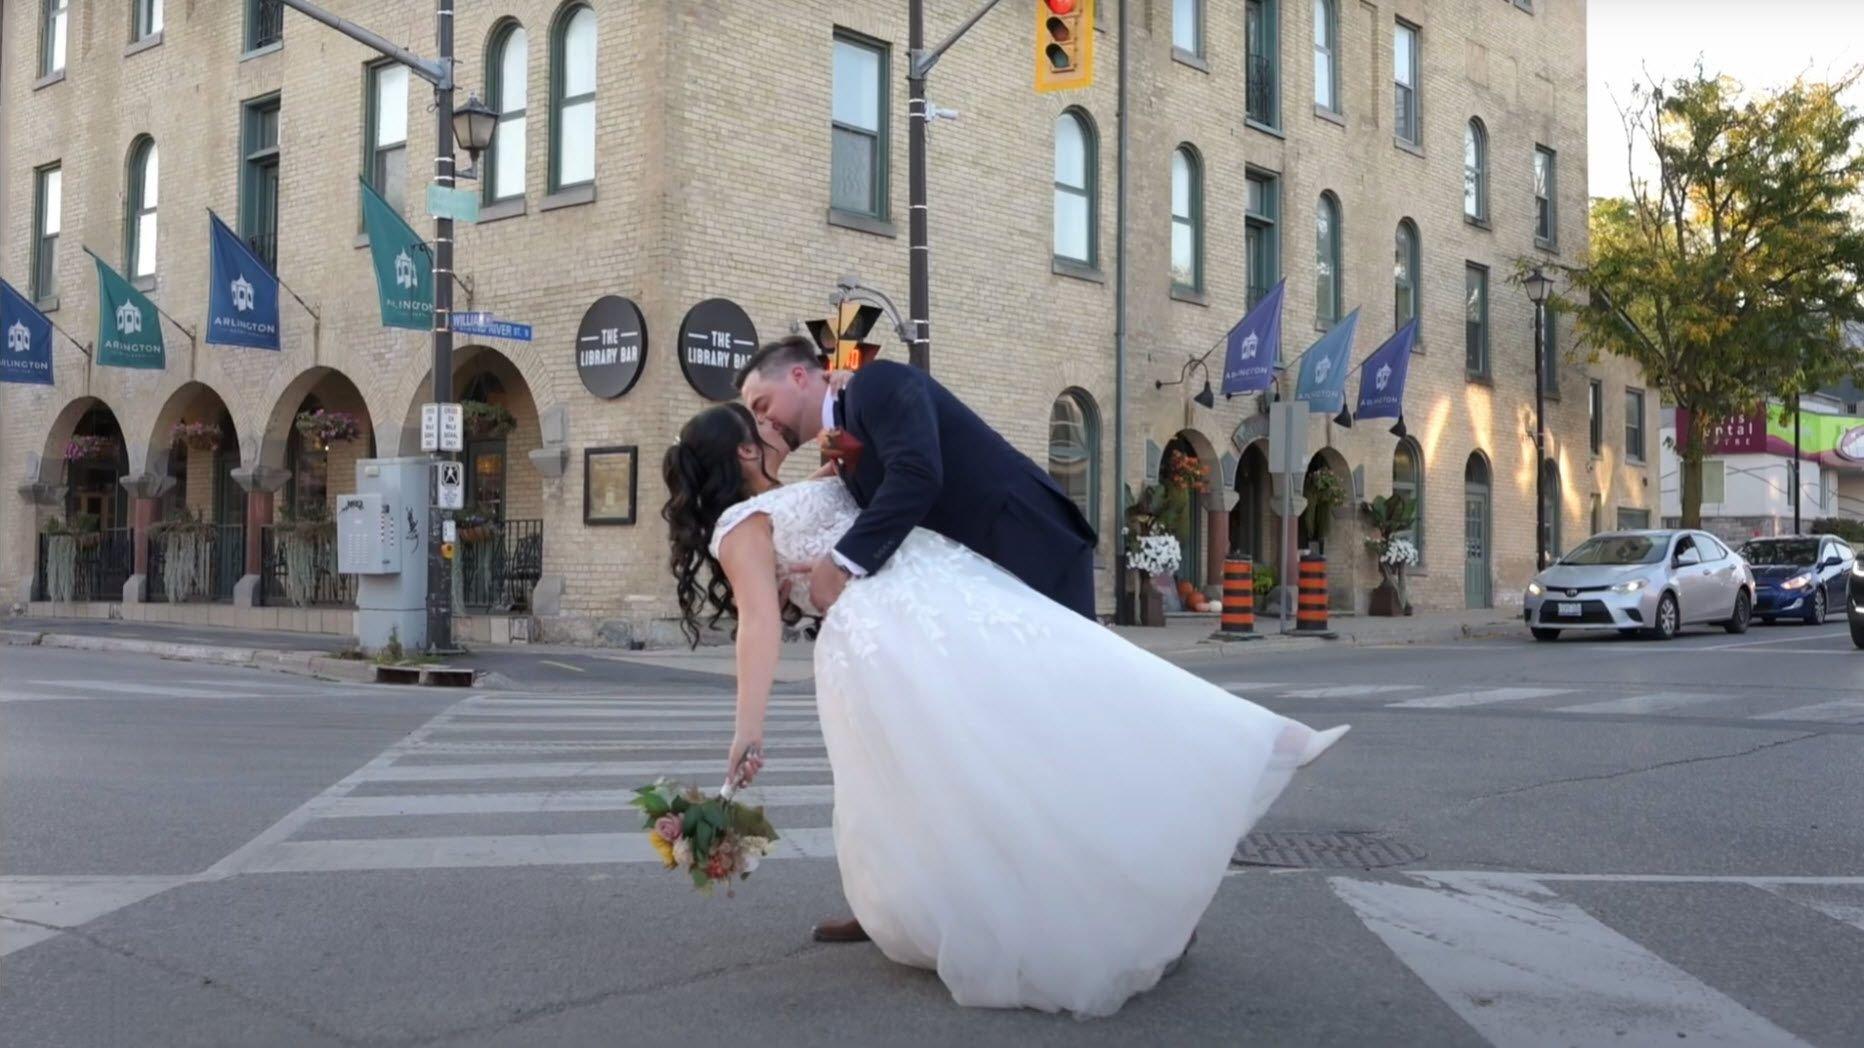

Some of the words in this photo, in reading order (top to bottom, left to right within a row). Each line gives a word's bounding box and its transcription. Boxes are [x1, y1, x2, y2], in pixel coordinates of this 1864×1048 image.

[453, 313, 485, 326] WILLIA
[601, 328, 619, 346] THE
[711, 331, 731, 348] THE
[105, 340, 161, 353] ARINGTON
[580, 348, 617, 367] LIBRARY
[620, 346, 638, 363] BAR
[688, 347, 730, 368] LIBRARY
